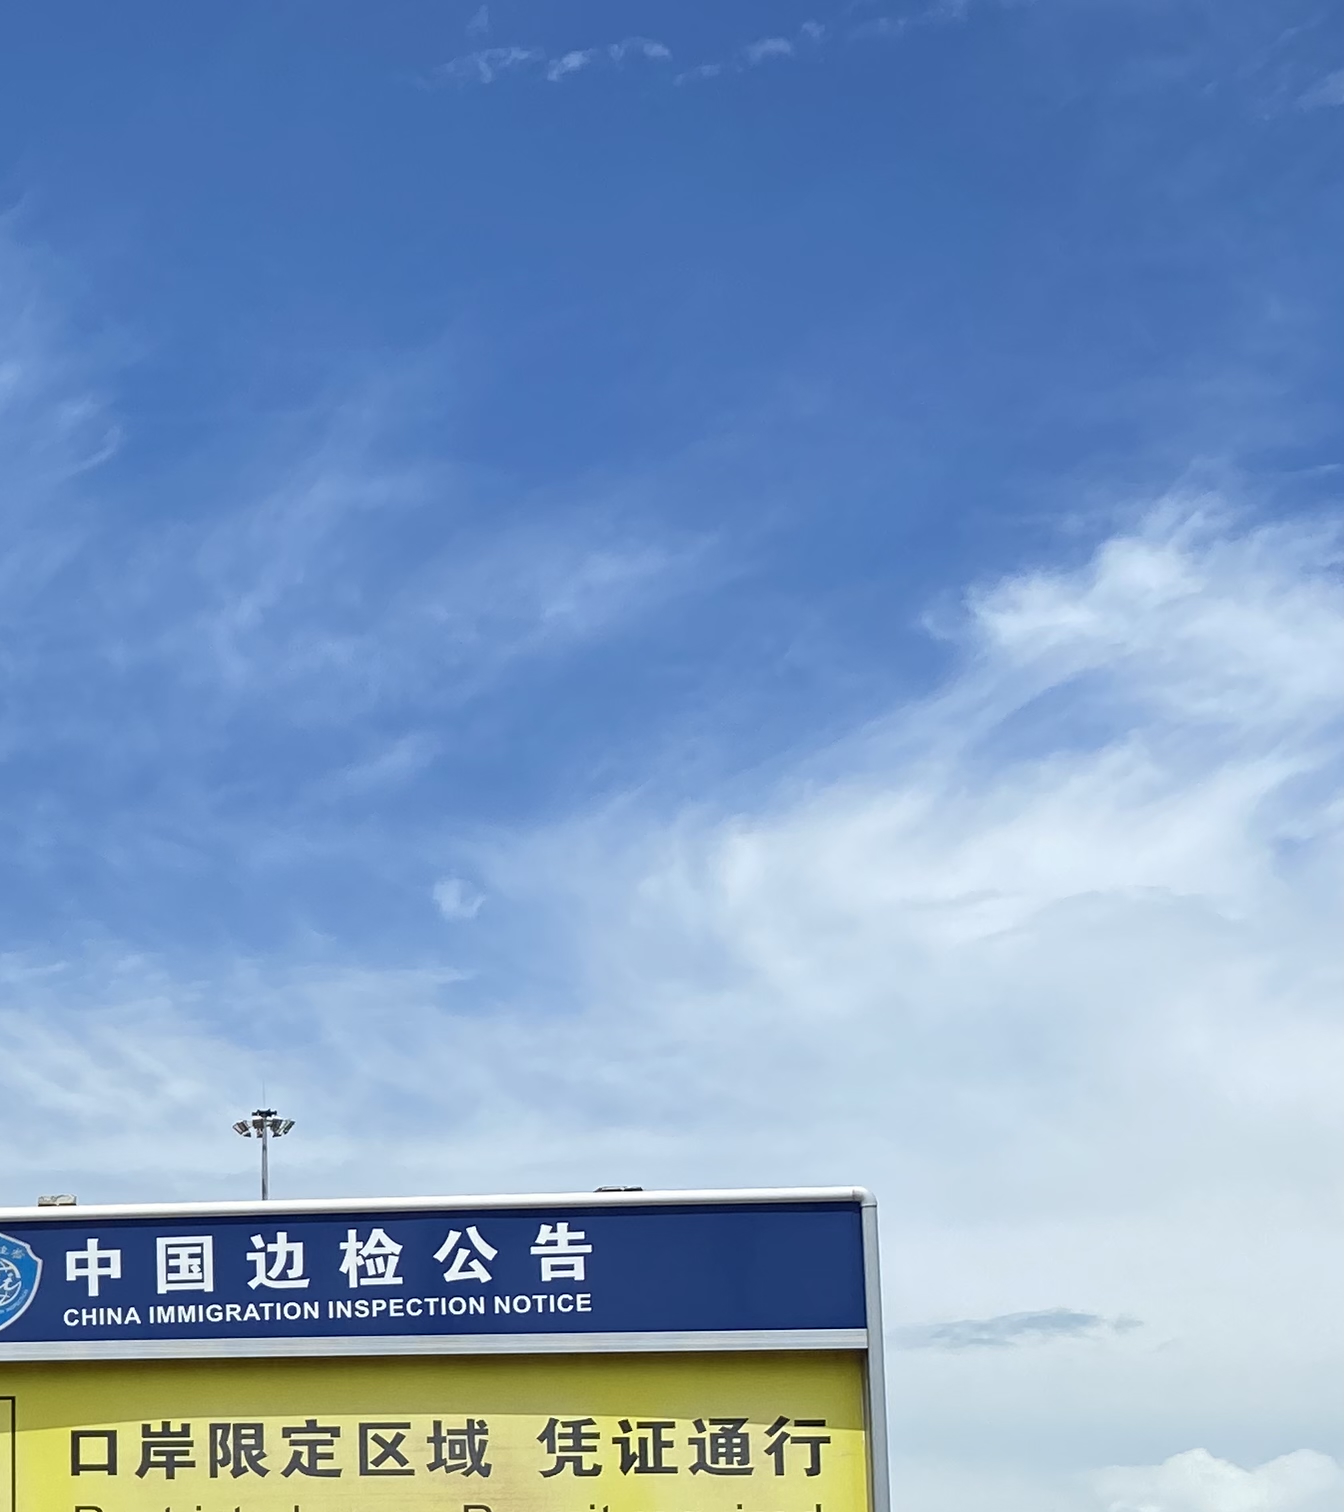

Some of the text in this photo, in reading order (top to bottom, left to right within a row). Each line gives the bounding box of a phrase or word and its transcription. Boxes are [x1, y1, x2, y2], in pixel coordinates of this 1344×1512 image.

[65, 1222, 593, 1297] 中国边检公告
[64, 1294, 591, 1326] CHINA IMMIGRATION INSPECTION NOTICE
[69, 1416, 832, 1481] 口岸限定区域 凭证通行
